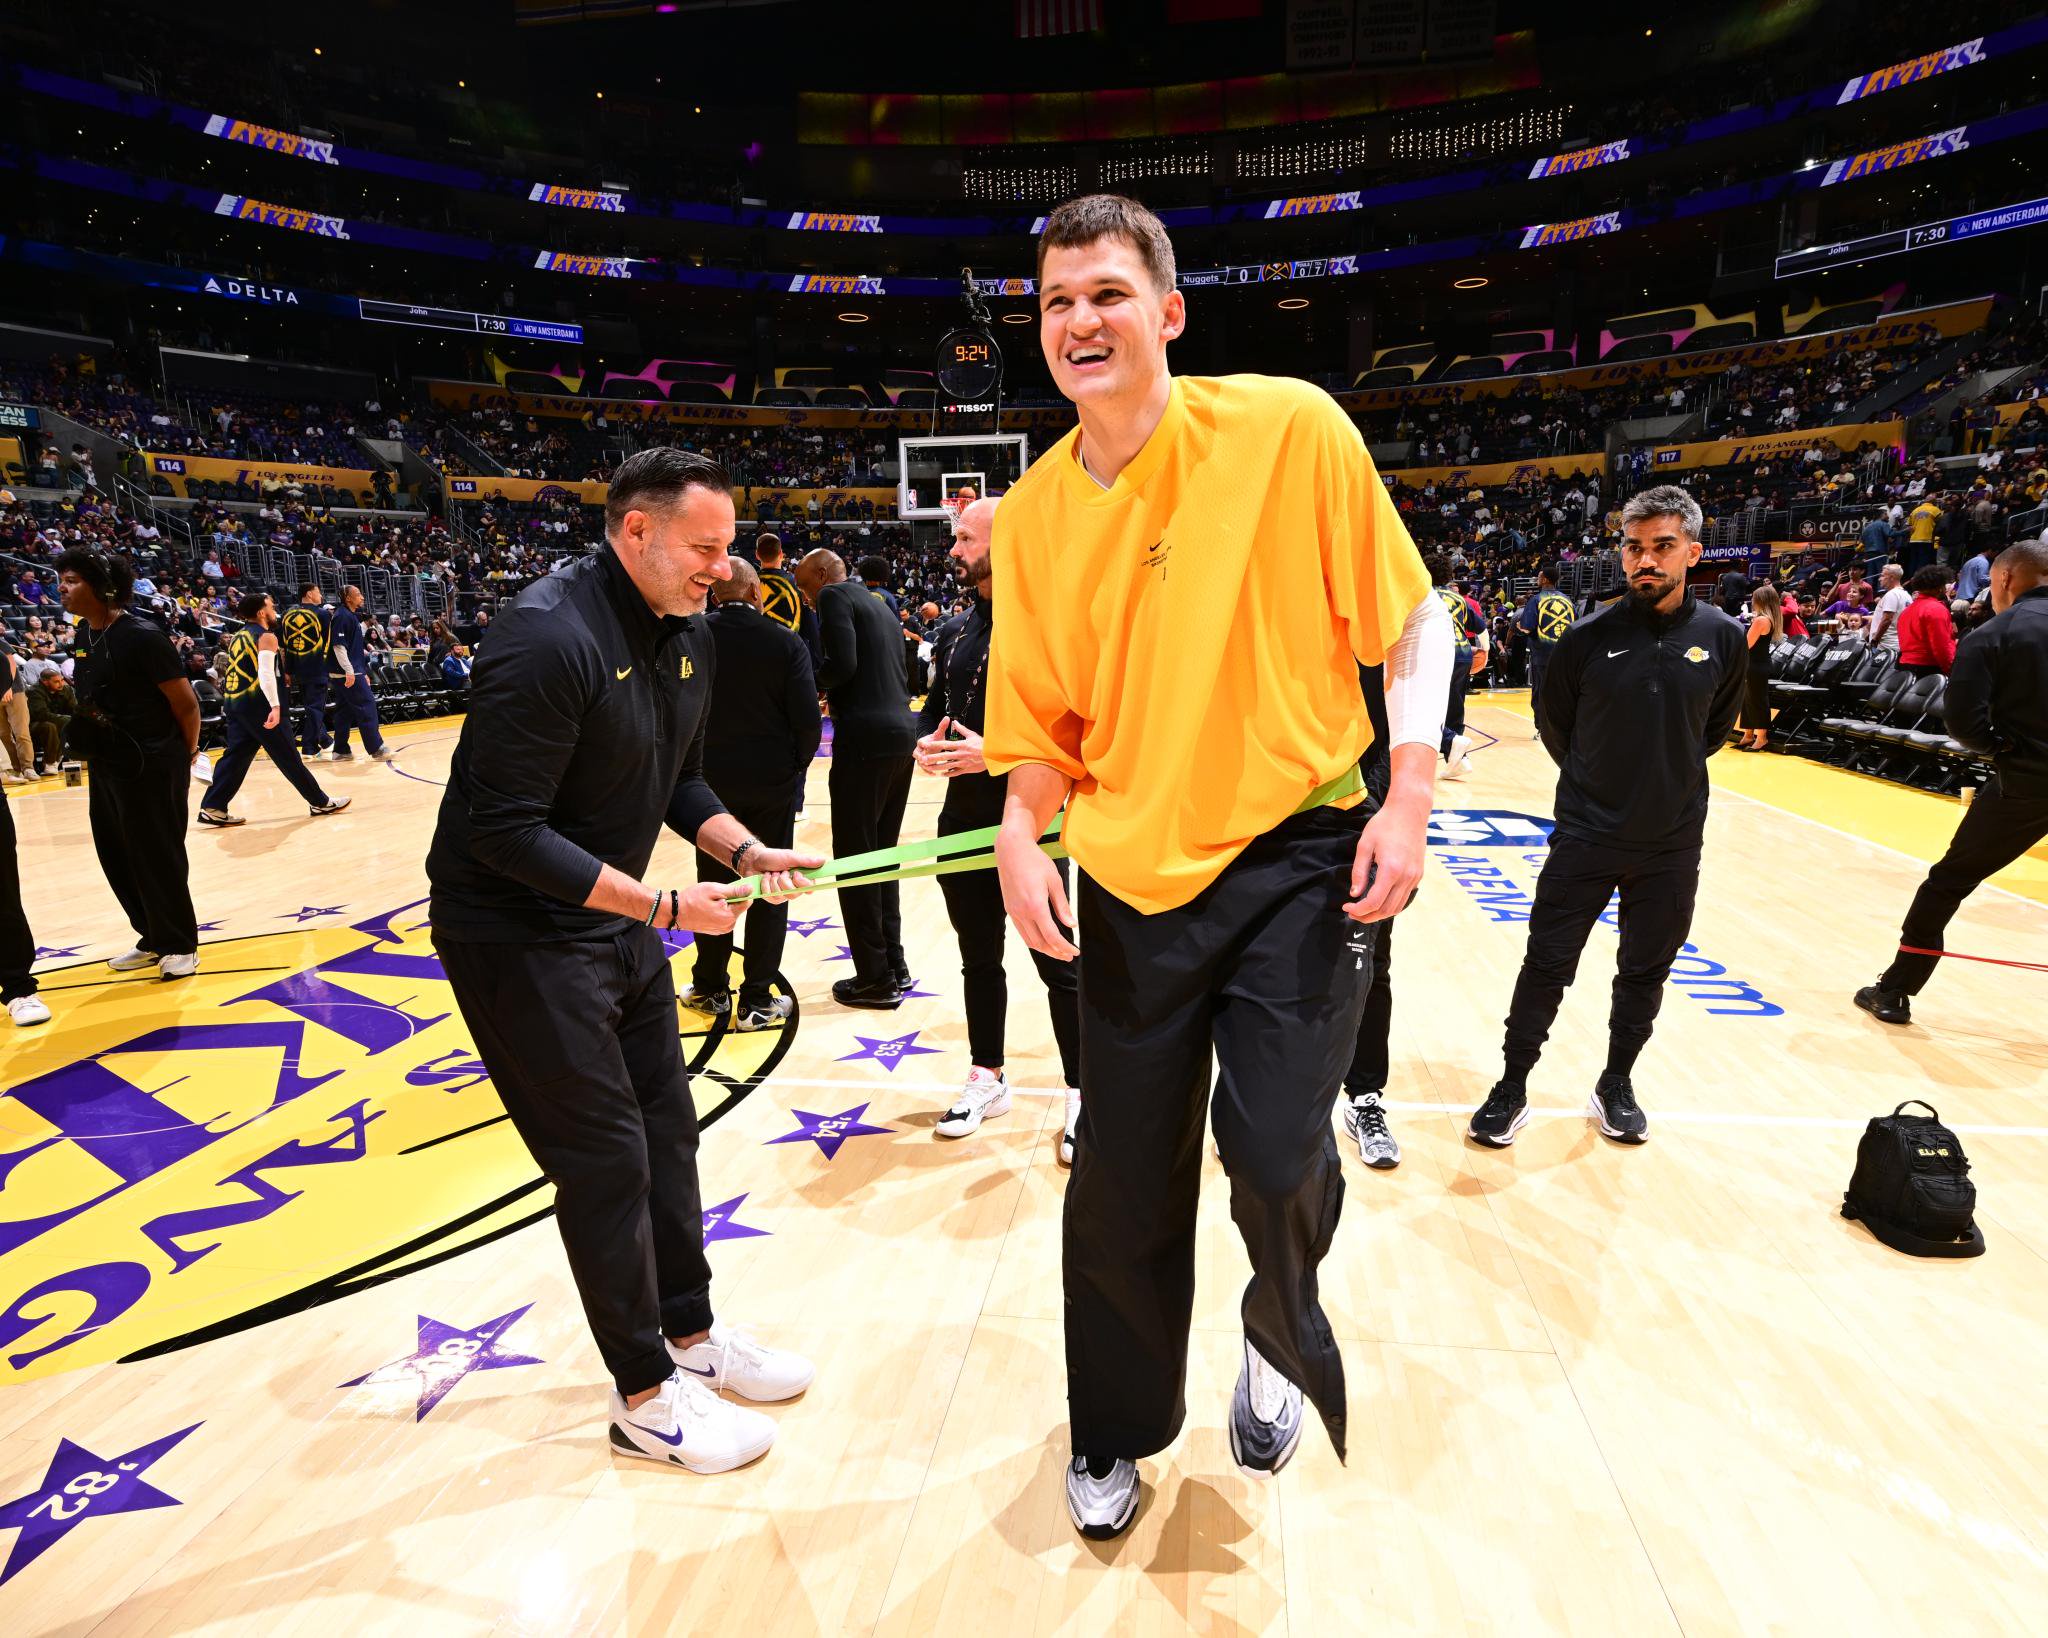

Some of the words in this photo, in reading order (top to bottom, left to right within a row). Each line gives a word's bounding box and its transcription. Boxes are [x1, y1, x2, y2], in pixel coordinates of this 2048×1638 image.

[1972, 217, 1992, 231] NEW
[1915, 227, 1945, 243] 7:30
[1828, 245, 1849, 256] John
[1239, 269, 1248, 281] 0
[1300, 267, 1305, 276] 0
[1315, 266, 1320, 275] 7
[1183, 274, 1219, 285] Nuggets
[228, 281, 299, 305] DELTA
[989, 286, 995, 295] 0
[409, 307, 428, 316] John
[482, 319, 506, 331] 7:30
[524, 324, 537, 335] NEW
[537, 326, 575, 339] AMSTERDAM
[955, 345, 988, 362] 9:24
[958, 403, 995, 413] TISSOT
[1660, 452, 1676, 463] 117
[158, 459, 182, 472] 114
[454, 482, 473, 491] 114
[1434, 852, 1535, 922] ARENA
[873, 1041, 907, 1057] '53
[811, 1116, 853, 1138] '54
[26, 1461, 140, 1521] '82
